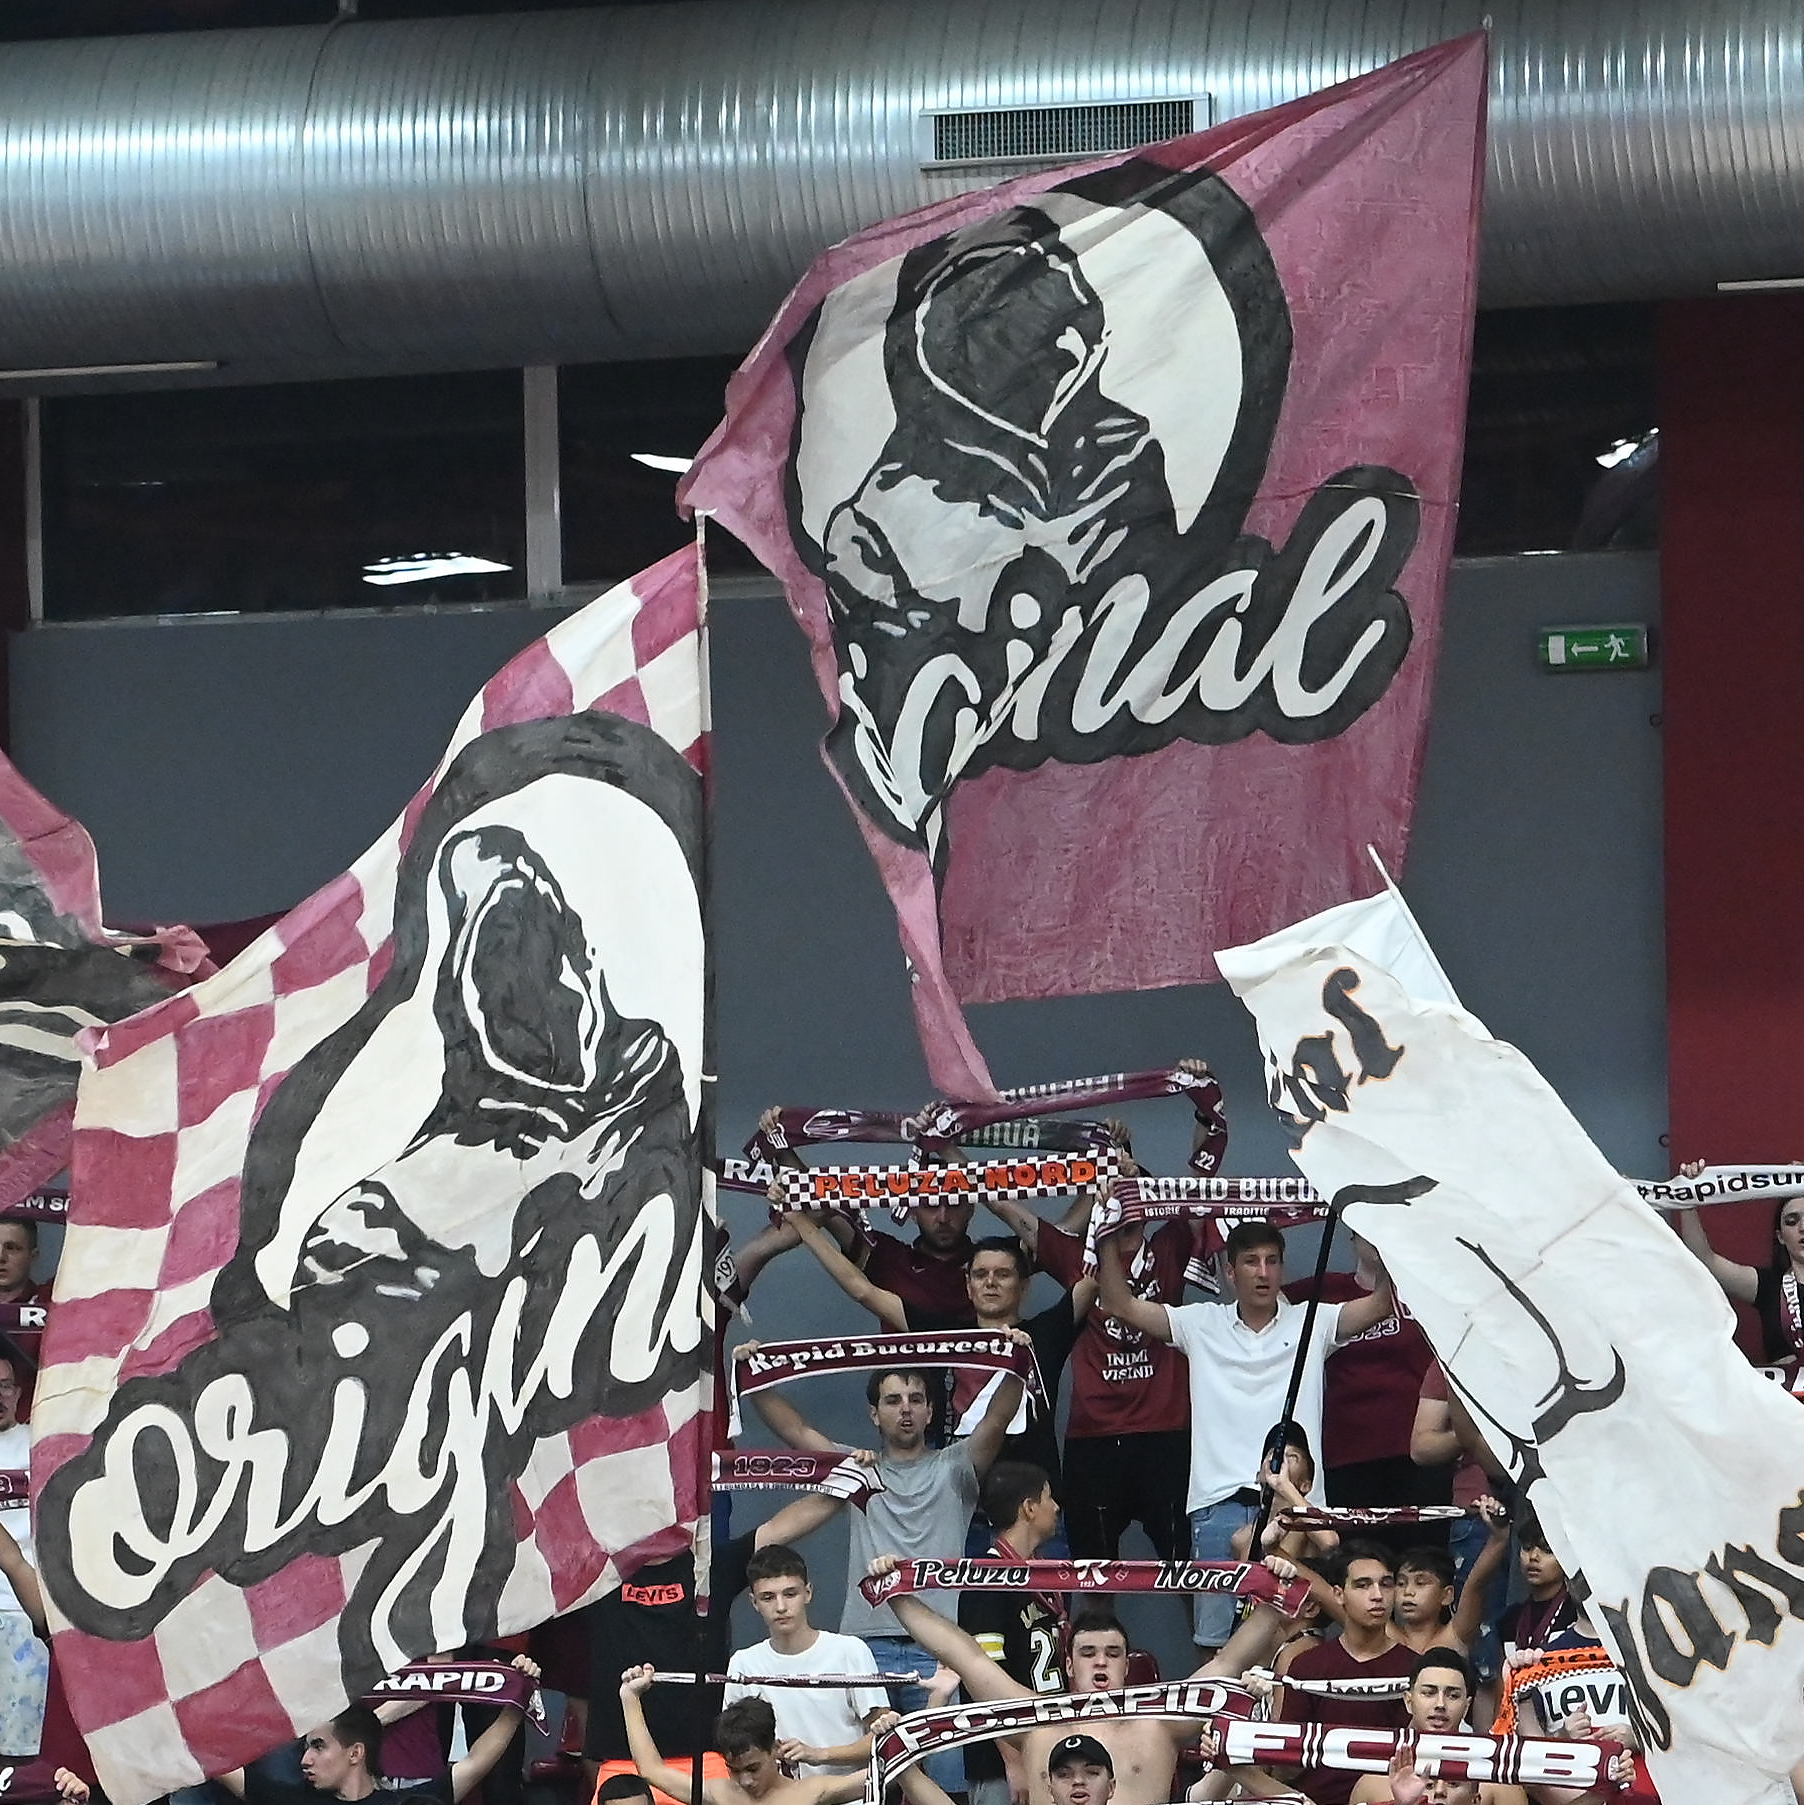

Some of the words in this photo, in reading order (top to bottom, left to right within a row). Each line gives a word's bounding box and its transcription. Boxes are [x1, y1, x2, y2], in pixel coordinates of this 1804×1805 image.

[813, 1165, 978, 1199] PELUZA
[985, 1158, 1097, 1189] NORD
[1138, 1174, 1231, 1202] RAPID
[748, 1341, 847, 1377] Rapid
[733, 1455, 817, 1477] 1923
[913, 1559, 1031, 1589] Peluza
[1156, 1561, 1251, 1593] Nord
[379, 1670, 506, 1693] RAPID
[904, 1704, 1018, 1755] F.C.
[1033, 1678, 1230, 1724] RAPID
